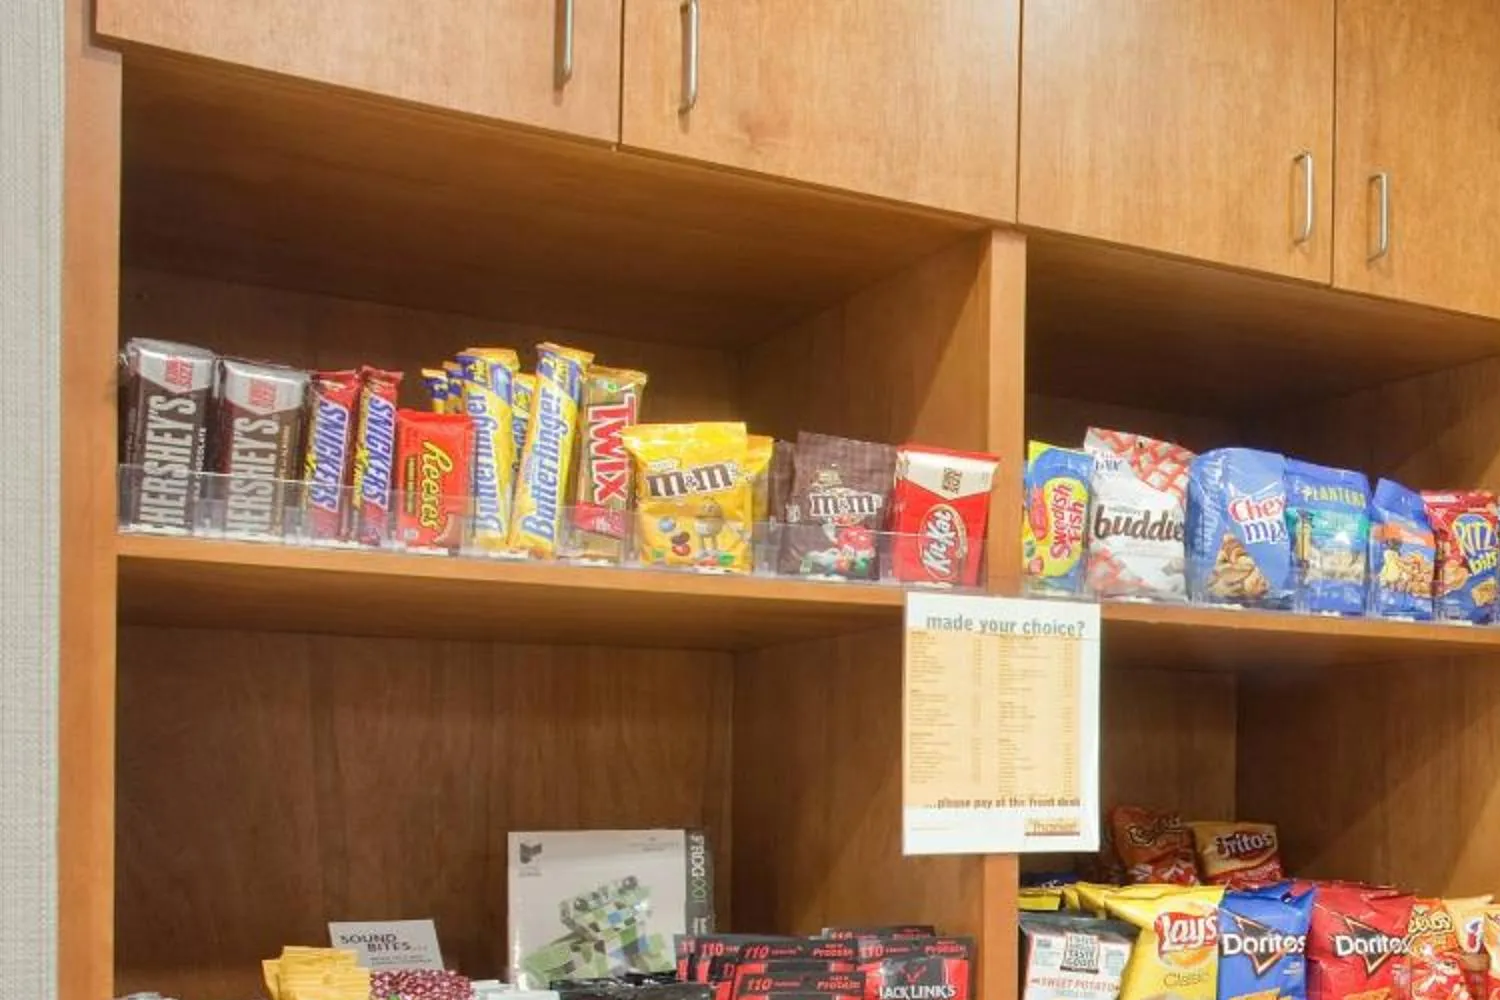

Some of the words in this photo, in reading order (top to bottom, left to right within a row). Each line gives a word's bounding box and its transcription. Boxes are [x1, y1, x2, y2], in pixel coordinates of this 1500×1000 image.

[139, 393, 197, 534] HERSHEY'S
[226, 415, 280, 536] HERSHEY'S
[312, 399, 349, 511] SNICKERS
[361, 396, 397, 510] SNICKERS
[521, 386, 569, 540] Butterfinger
[588, 392, 638, 505] TWIX
[927, 614, 974, 631] made
[979, 618, 1017, 635] your
[1022, 619, 1086, 637] choice?
[339, 933, 397, 945] SOUND
[1222, 932, 1307, 956] Doritos
[1335, 934, 1410, 957] Doritos
